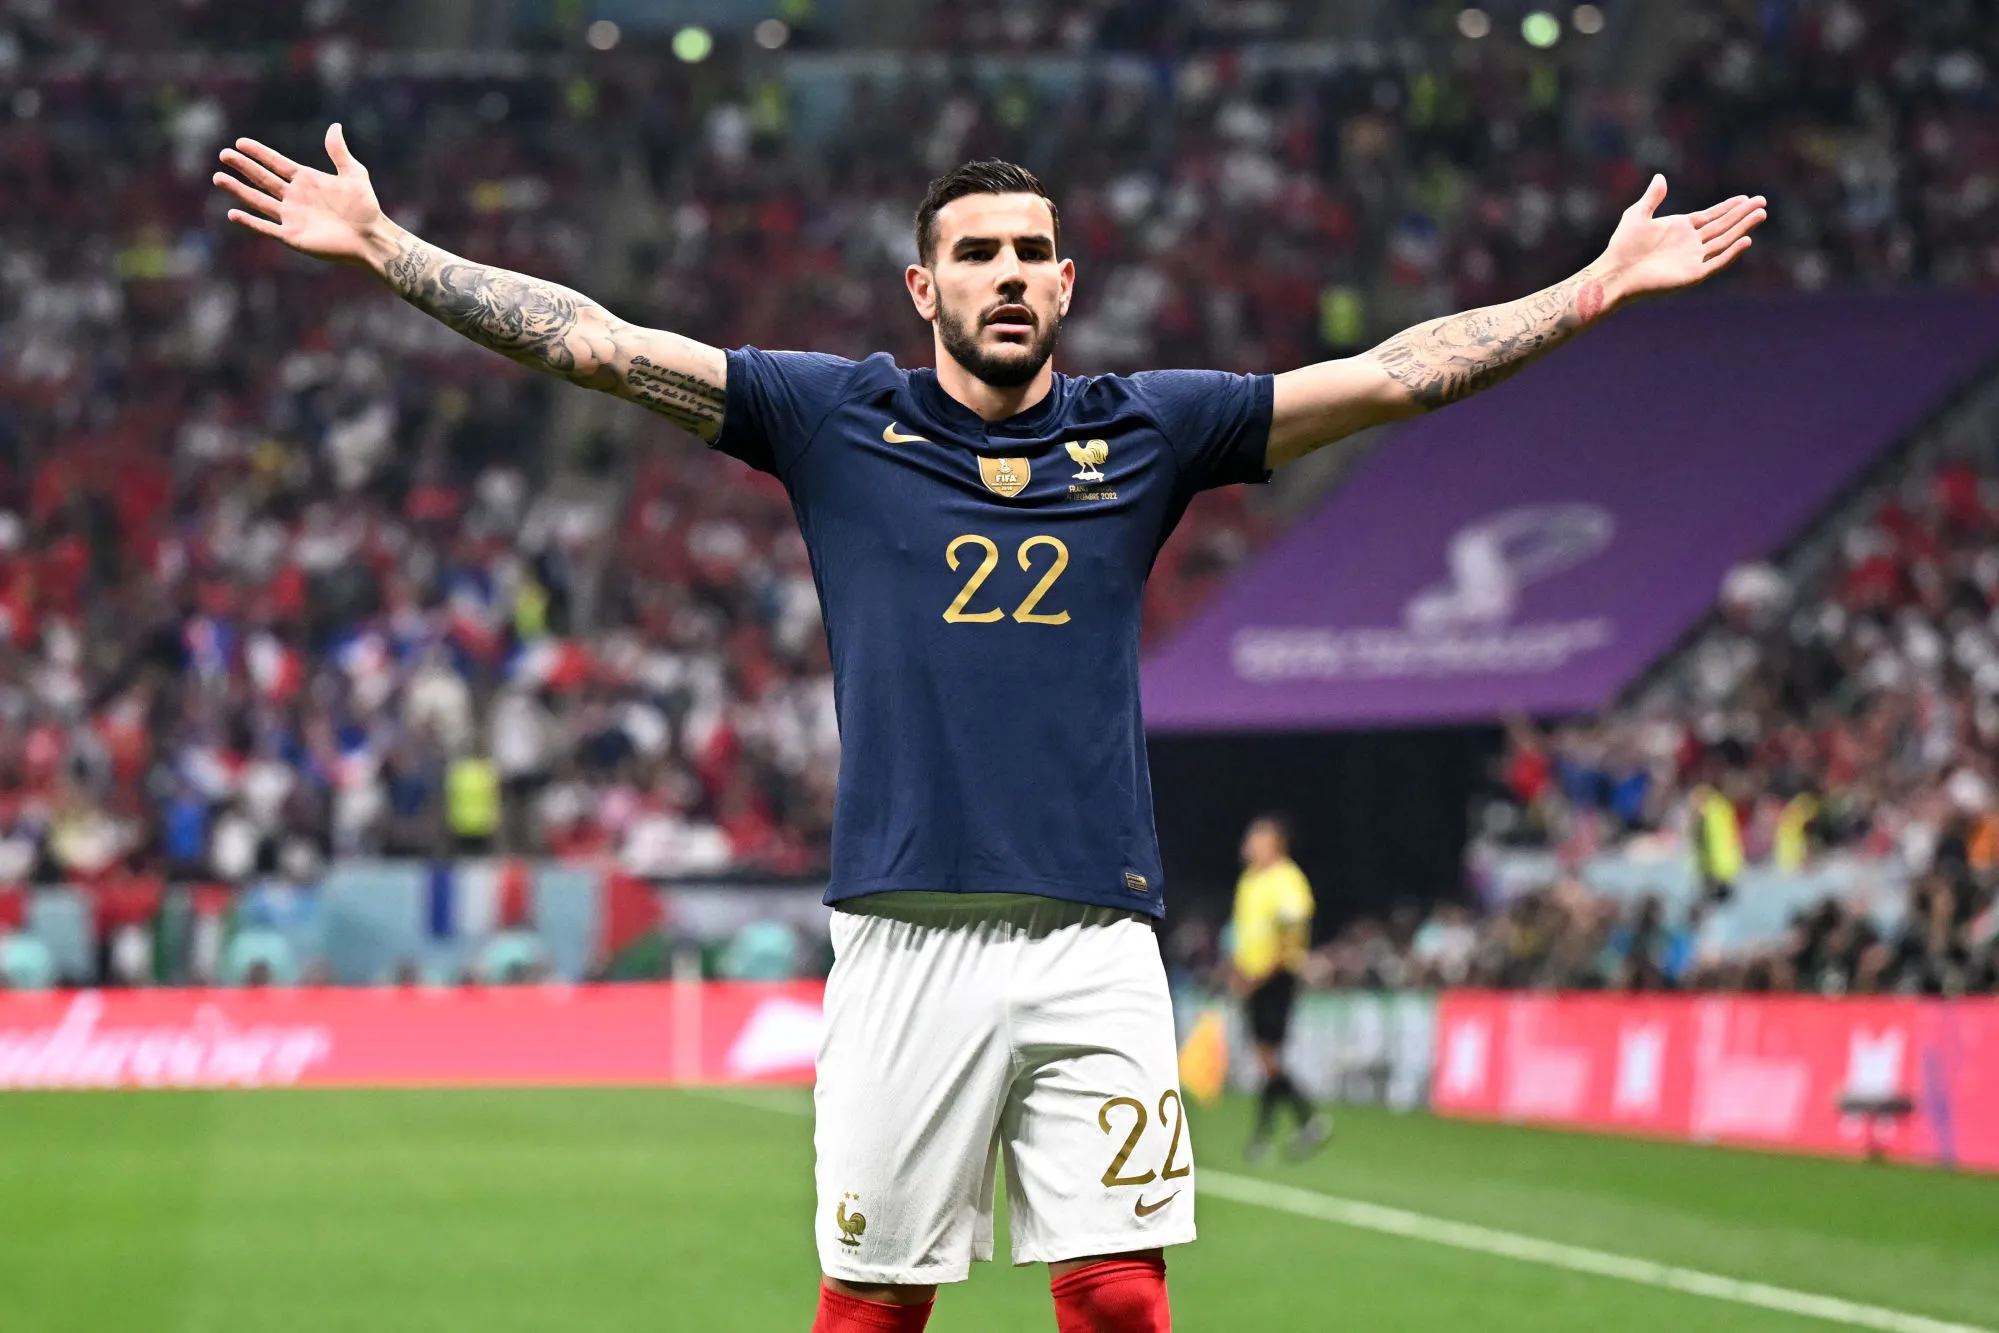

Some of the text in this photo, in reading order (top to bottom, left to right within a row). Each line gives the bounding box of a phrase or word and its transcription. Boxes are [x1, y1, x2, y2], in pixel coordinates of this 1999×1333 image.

[996, 474, 1017, 482] FIFA
[1100, 491, 1118, 500] 2022
[942, 534, 1072, 626] 22
[1098, 1089, 1190, 1188] 22
